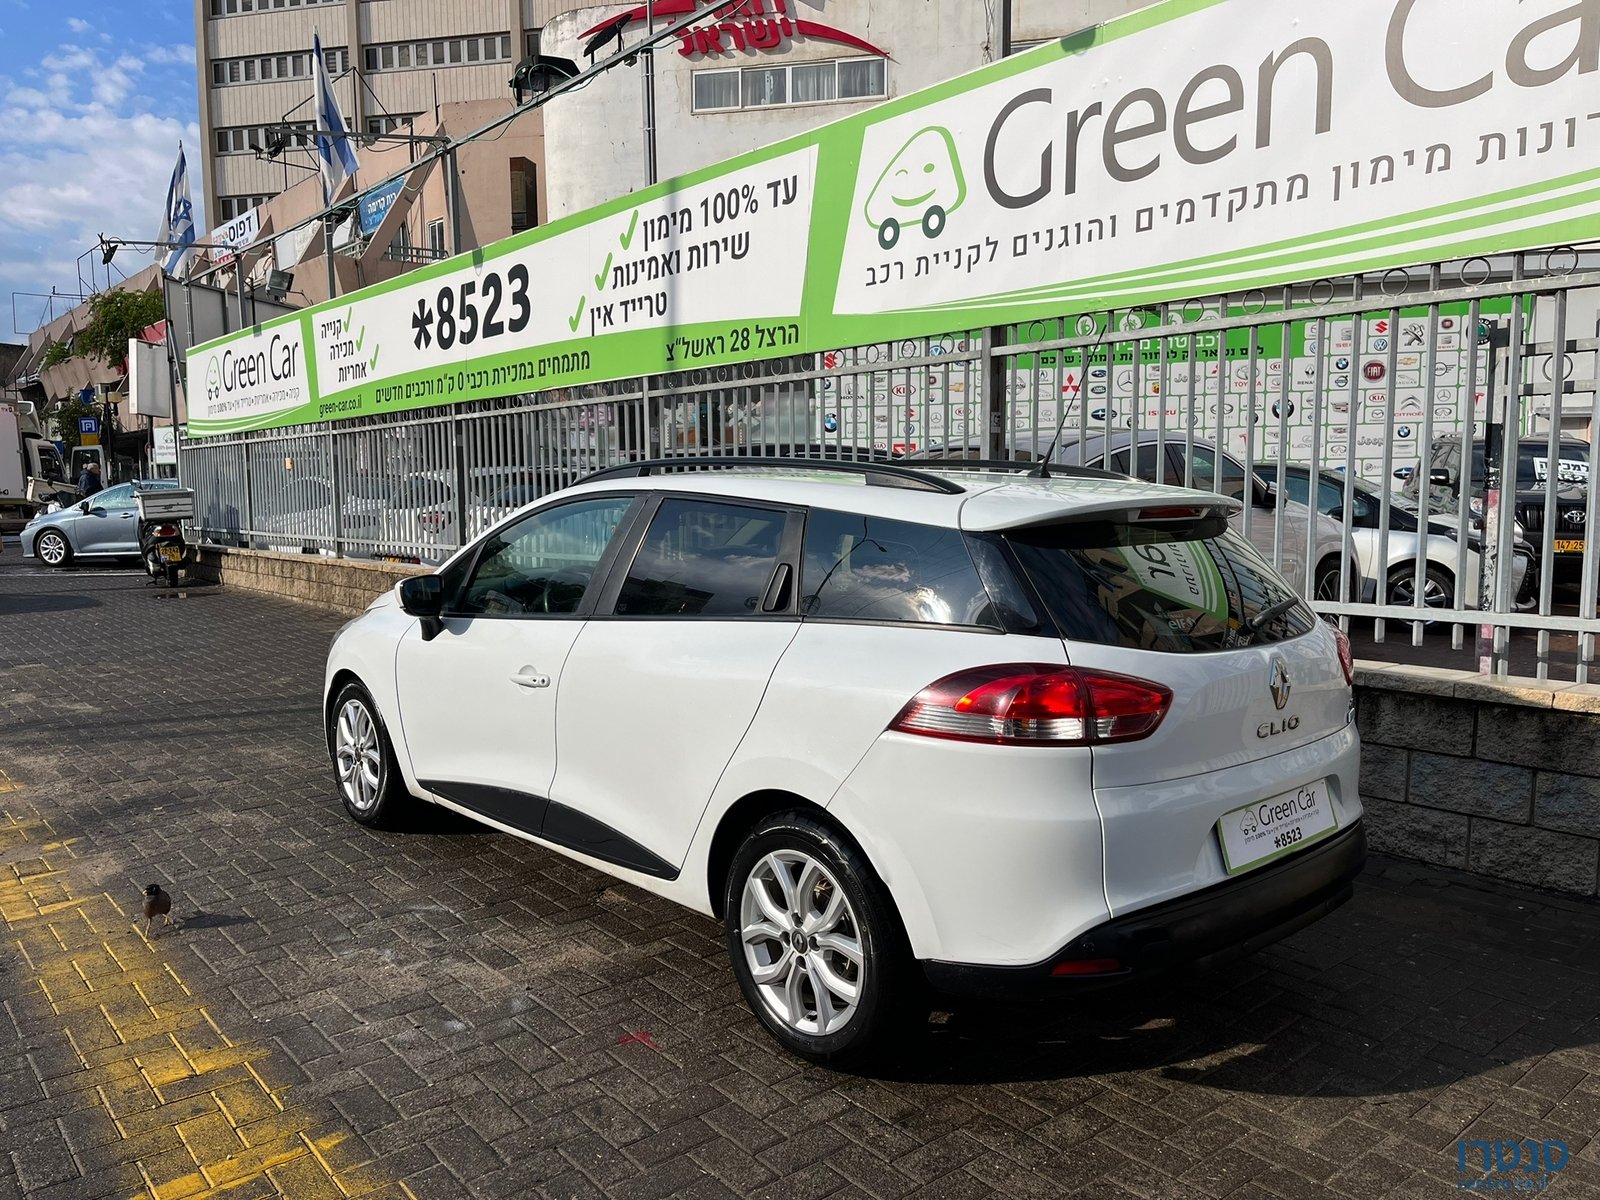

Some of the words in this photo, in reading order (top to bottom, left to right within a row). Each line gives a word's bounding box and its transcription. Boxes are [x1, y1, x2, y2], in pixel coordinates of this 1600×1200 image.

[983, 36, 1334, 210] Green
[1332, 142, 1451, 202] מימון
[766, 174, 799, 208] עד
[1134, 172, 1310, 234] מתקדמים
[700, 183, 759, 228] 100%
[228, 215, 252, 242] דפוס
[642, 207, 693, 252] מימון
[1012, 214, 1118, 258] והוגנים
[686, 230, 751, 272] שירות
[914, 235, 999, 279] לקניית
[612, 248, 682, 290] ואמינות
[865, 261, 904, 287] רכב
[589, 302, 615, 337] אין
[619, 290, 668, 324] טרייד
[320, 318, 342, 340] קנייה
[729, 326, 751, 353] 28
[755, 322, 800, 349] הרצל
[222, 349, 266, 392] Green
[269, 333, 298, 381] Car
[329, 338, 354, 361] מכירה
[338, 361, 368, 384] אחריות
[492, 360, 535, 386] במכירת
[538, 350, 592, 377] מתמחים
[375, 384, 404, 403] חדשים
[405, 379, 434, 398] ורכבים
[457, 373, 464, 392] 0
[466, 370, 489, 390] רכבי
[318, 394, 362, 418] green-car.co.il
[1256, 714, 1301, 739] CLIO
[1258, 799, 1298, 826] Green
[1297, 789, 1316, 811] Car
